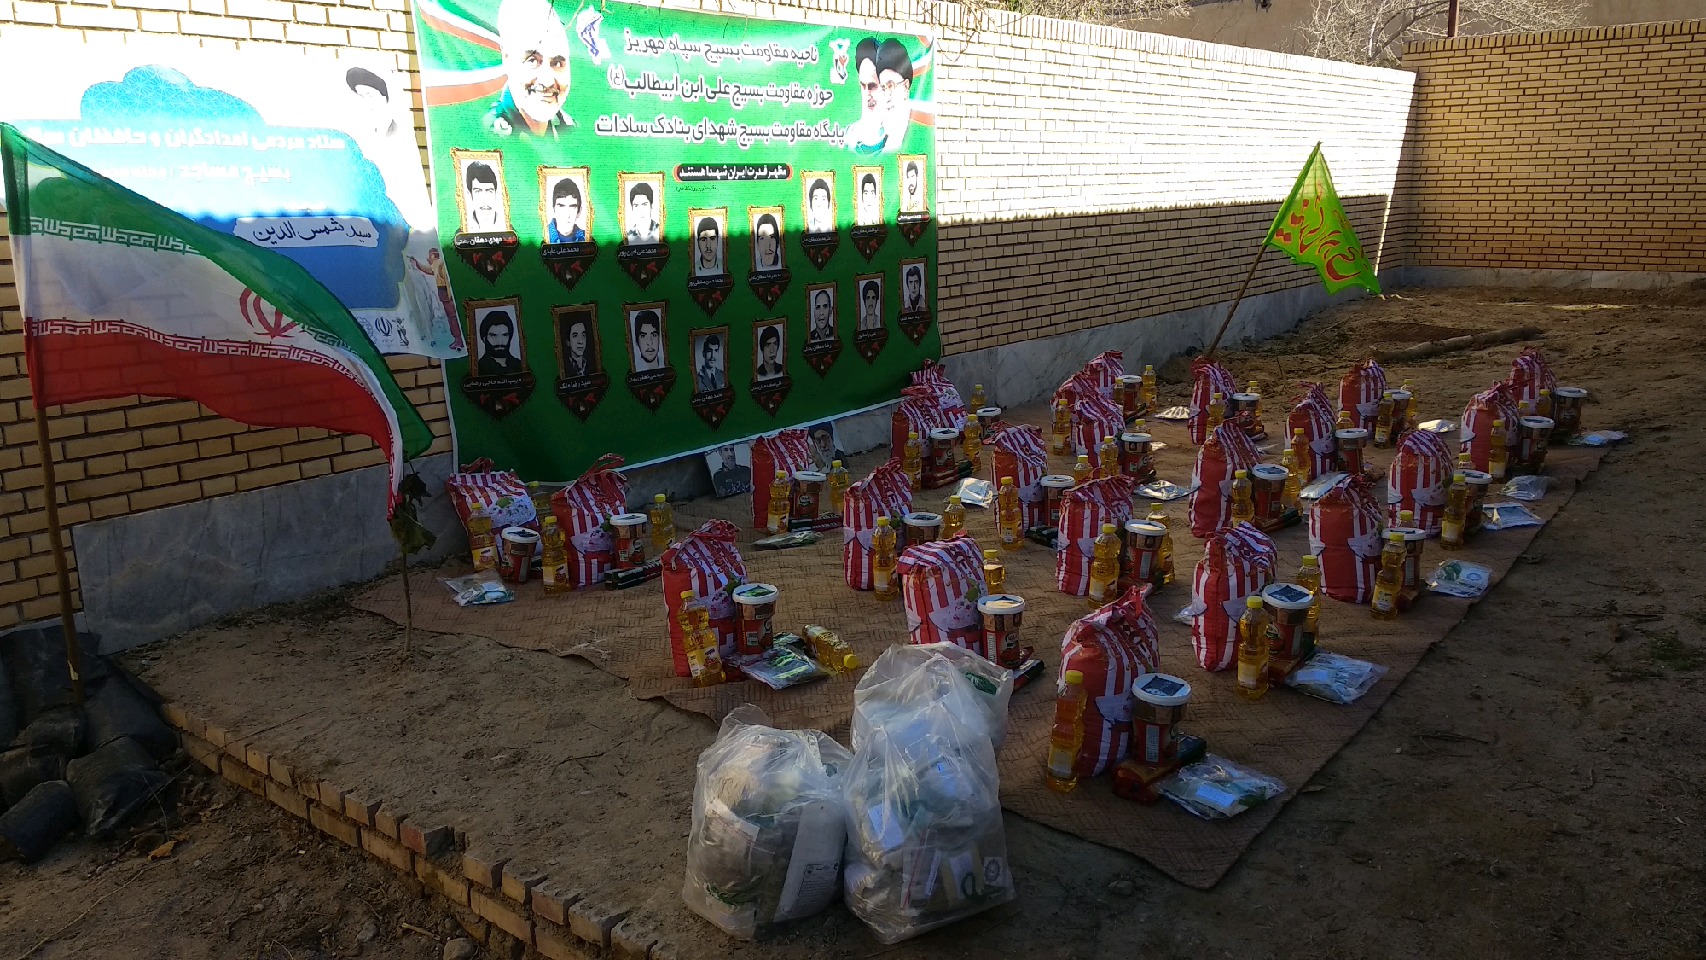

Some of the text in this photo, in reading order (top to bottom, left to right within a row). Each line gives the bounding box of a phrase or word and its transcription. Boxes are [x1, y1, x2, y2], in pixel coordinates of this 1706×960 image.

[625, 30, 665, 54] مهریز
[668, 35, 701, 59] سپاه
[741, 43, 789, 62] مقاومت
[704, 43, 740, 63] بسیج
[682, 77, 703, 99] ابن
[705, 78, 730, 99] علی
[732, 84, 764, 106] بسیج
[766, 83, 806, 103] مقاومت
[807, 85, 833, 105] حوزه
[597, 115, 845, 147] پایگاه مقاومت بسیج شهدای بنادک سادات
[679, 164, 787, 180] مظهر قدرت ایران شهدا هستند
[253, 217, 372, 245] سید شمس الدین
